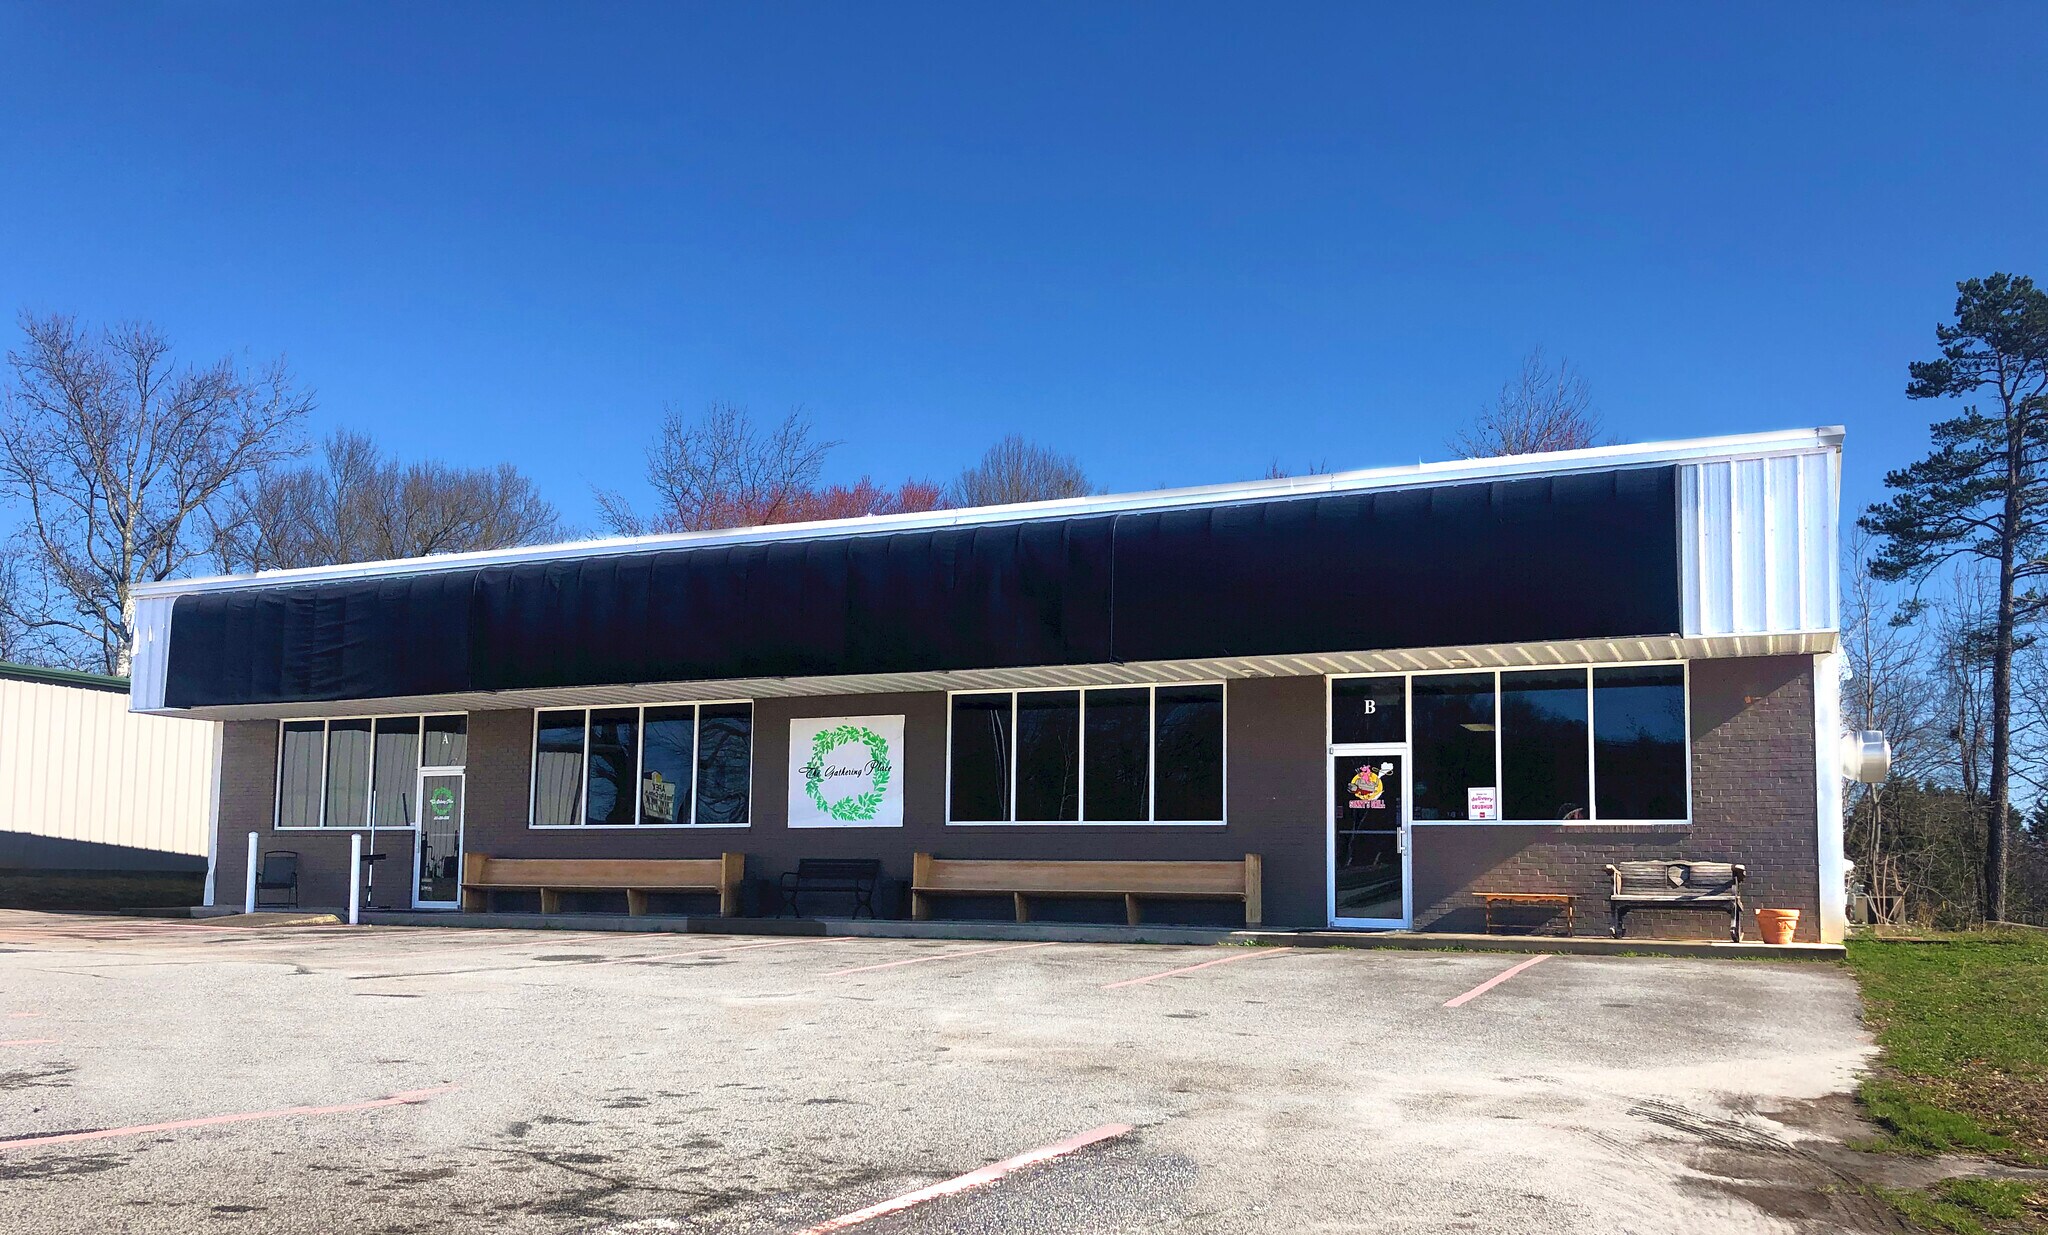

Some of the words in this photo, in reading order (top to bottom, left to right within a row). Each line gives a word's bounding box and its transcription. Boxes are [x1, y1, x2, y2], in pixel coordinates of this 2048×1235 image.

[1364, 699, 1376, 714] B
[442, 733, 449, 745] A
[798, 767, 820, 779] The
[824, 765, 862, 779] Gathering
[864, 760, 892, 776] Place
